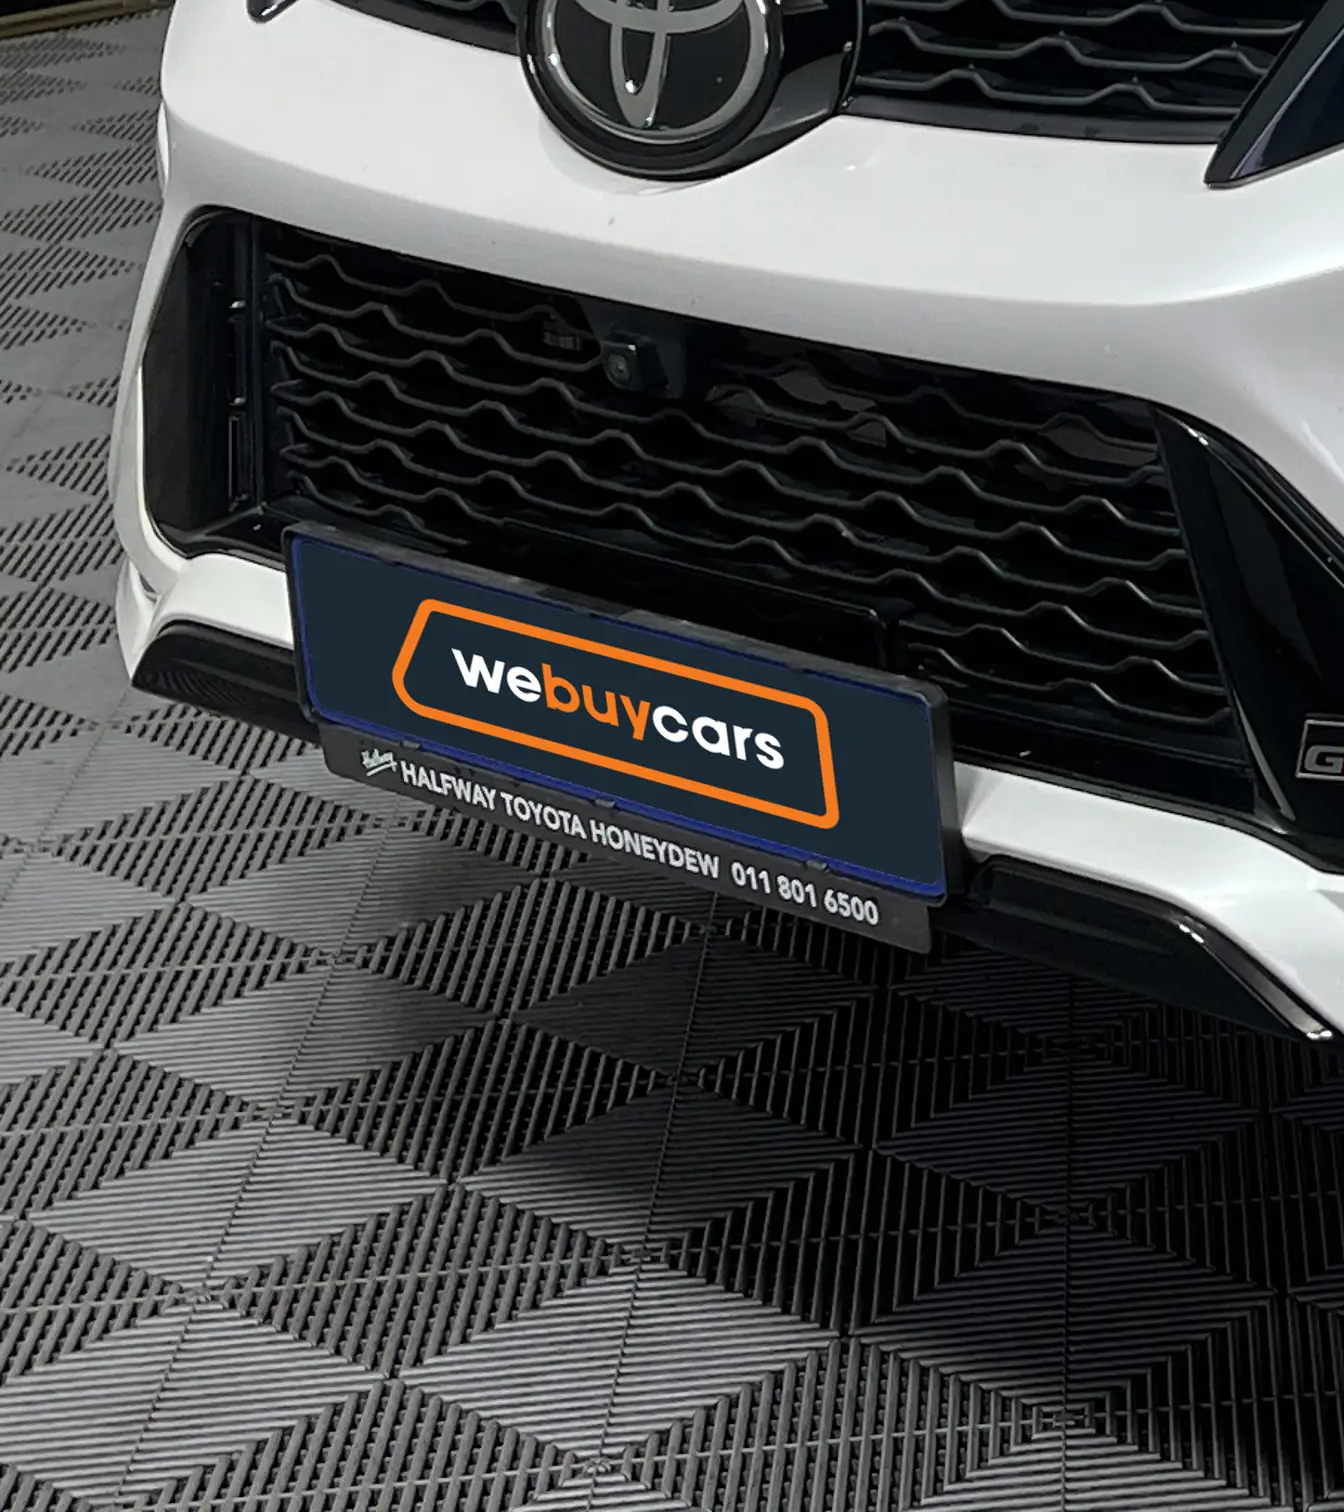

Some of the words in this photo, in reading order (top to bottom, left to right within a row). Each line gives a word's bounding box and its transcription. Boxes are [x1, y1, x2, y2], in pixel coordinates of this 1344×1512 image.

[400, 760, 497, 811] HALFWAY
[500, 792, 588, 840] TOYOTA
[590, 819, 720, 879] HONEYDEW
[731, 861, 771, 894] 011
[776, 875, 817, 908] 801
[823, 889, 879, 926] 6500
